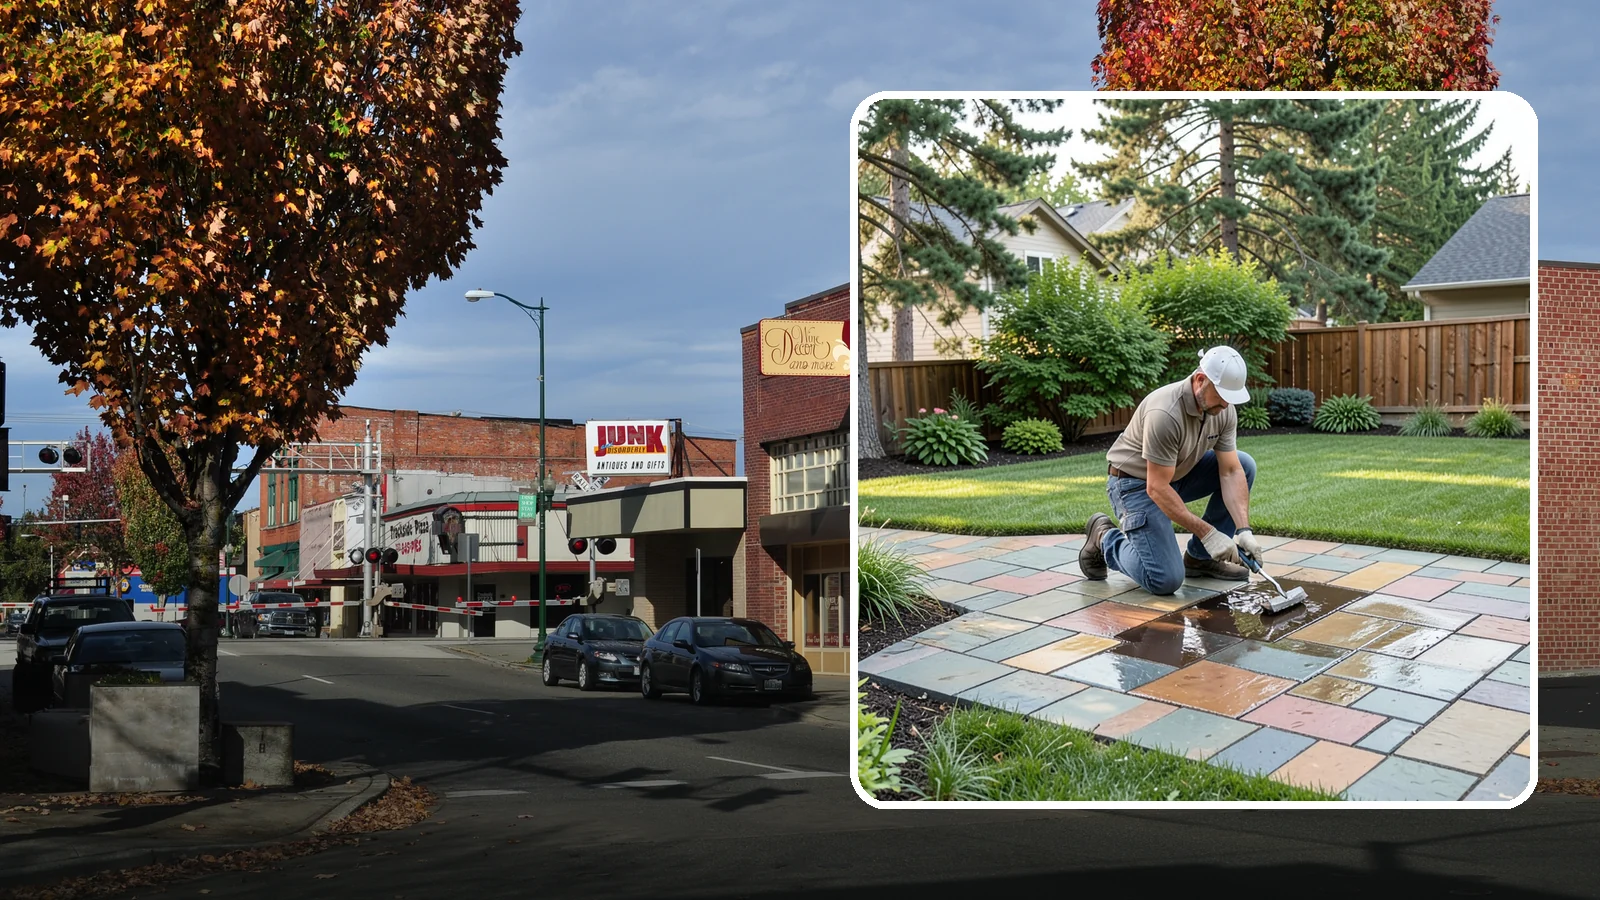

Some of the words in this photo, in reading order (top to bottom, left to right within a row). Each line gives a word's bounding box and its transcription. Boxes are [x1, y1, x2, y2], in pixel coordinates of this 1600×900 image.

[765, 327, 830, 365] Decor
[596, 425, 665, 457] JUNK
[607, 446, 646, 454] DISORDERLY
[597, 461, 628, 470] ANTIQUES
[631, 461, 644, 470] AND
[647, 460, 665, 469] GIFTS
[390, 521, 413, 540] Trackside
[415, 519, 429, 534] Pizza
